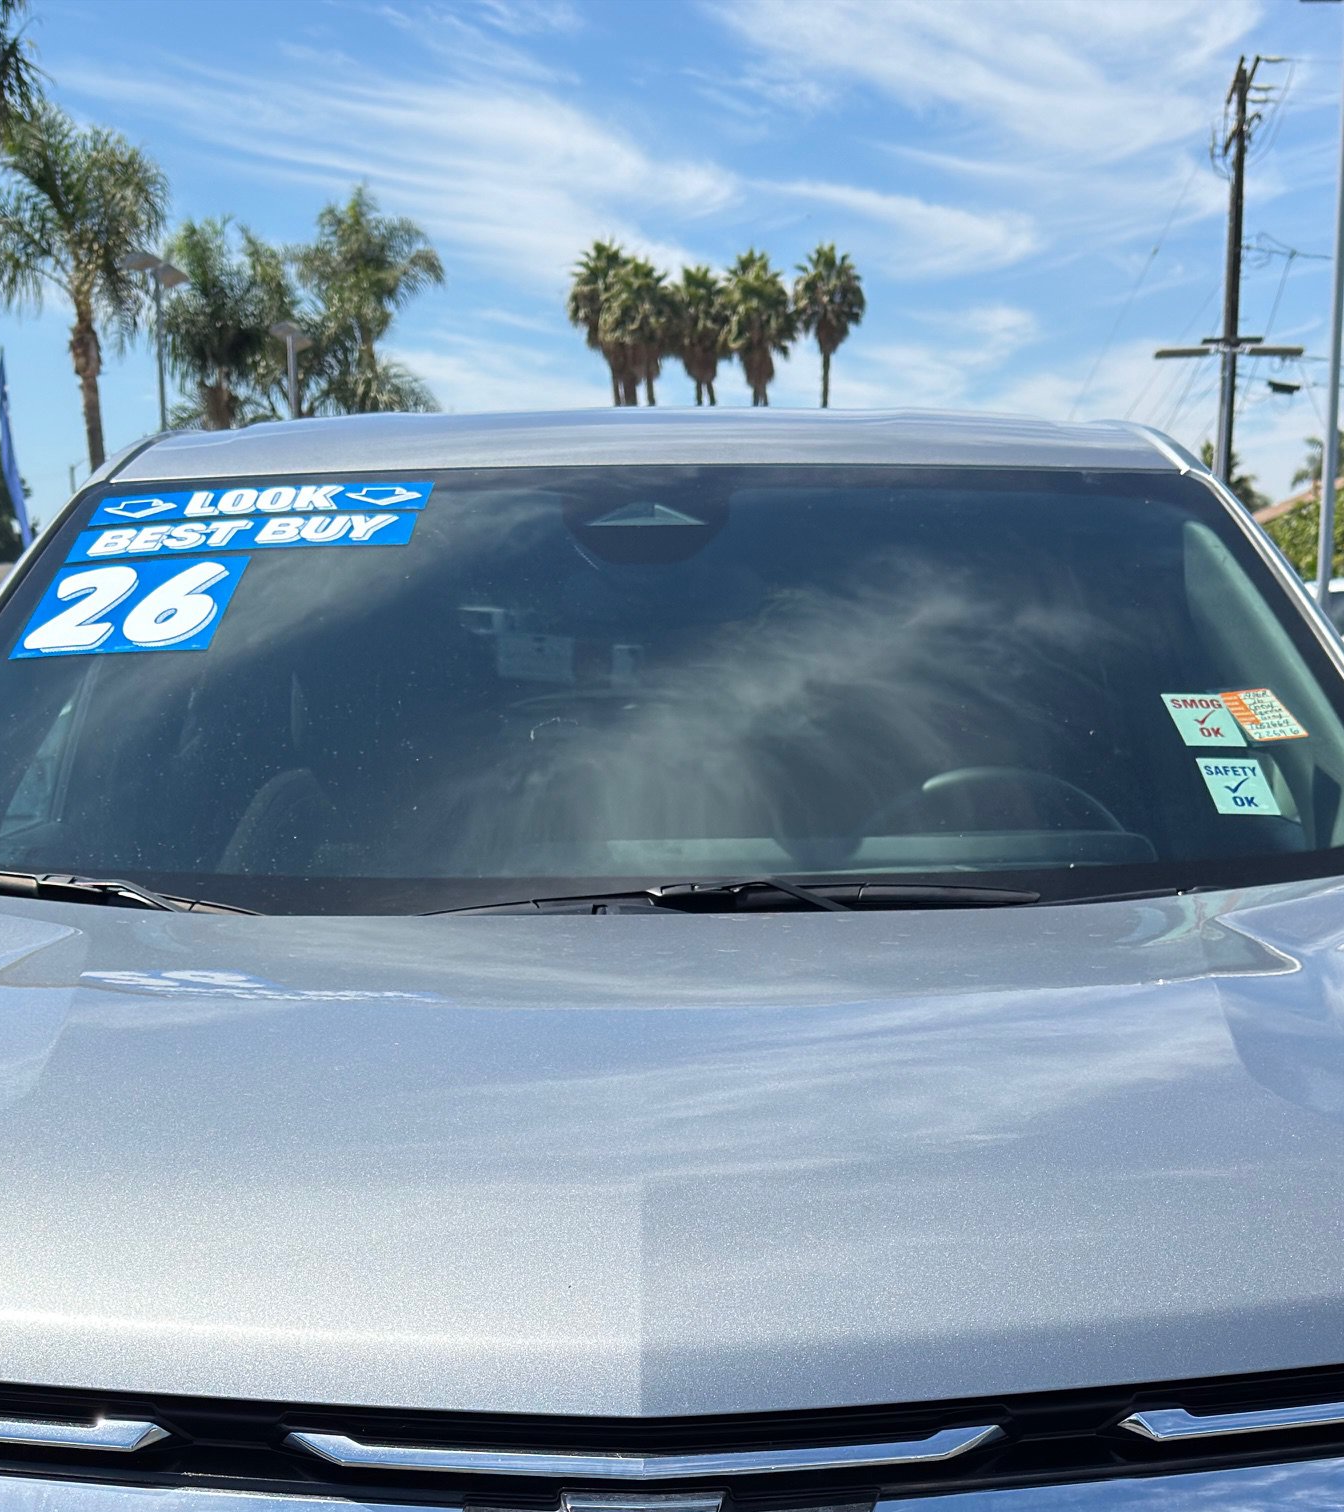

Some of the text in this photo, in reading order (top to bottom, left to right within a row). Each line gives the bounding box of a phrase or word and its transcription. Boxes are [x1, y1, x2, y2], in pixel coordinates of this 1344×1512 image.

[183, 484, 346, 518] LOOK
[86, 513, 400, 557] BEST BUY
[23, 561, 230, 654] 26
[1170, 698, 1223, 710] SMOG
[1199, 726, 1225, 738] OK
[1203, 765, 1257, 777] SAFETY
[1232, 795, 1258, 808] OK
